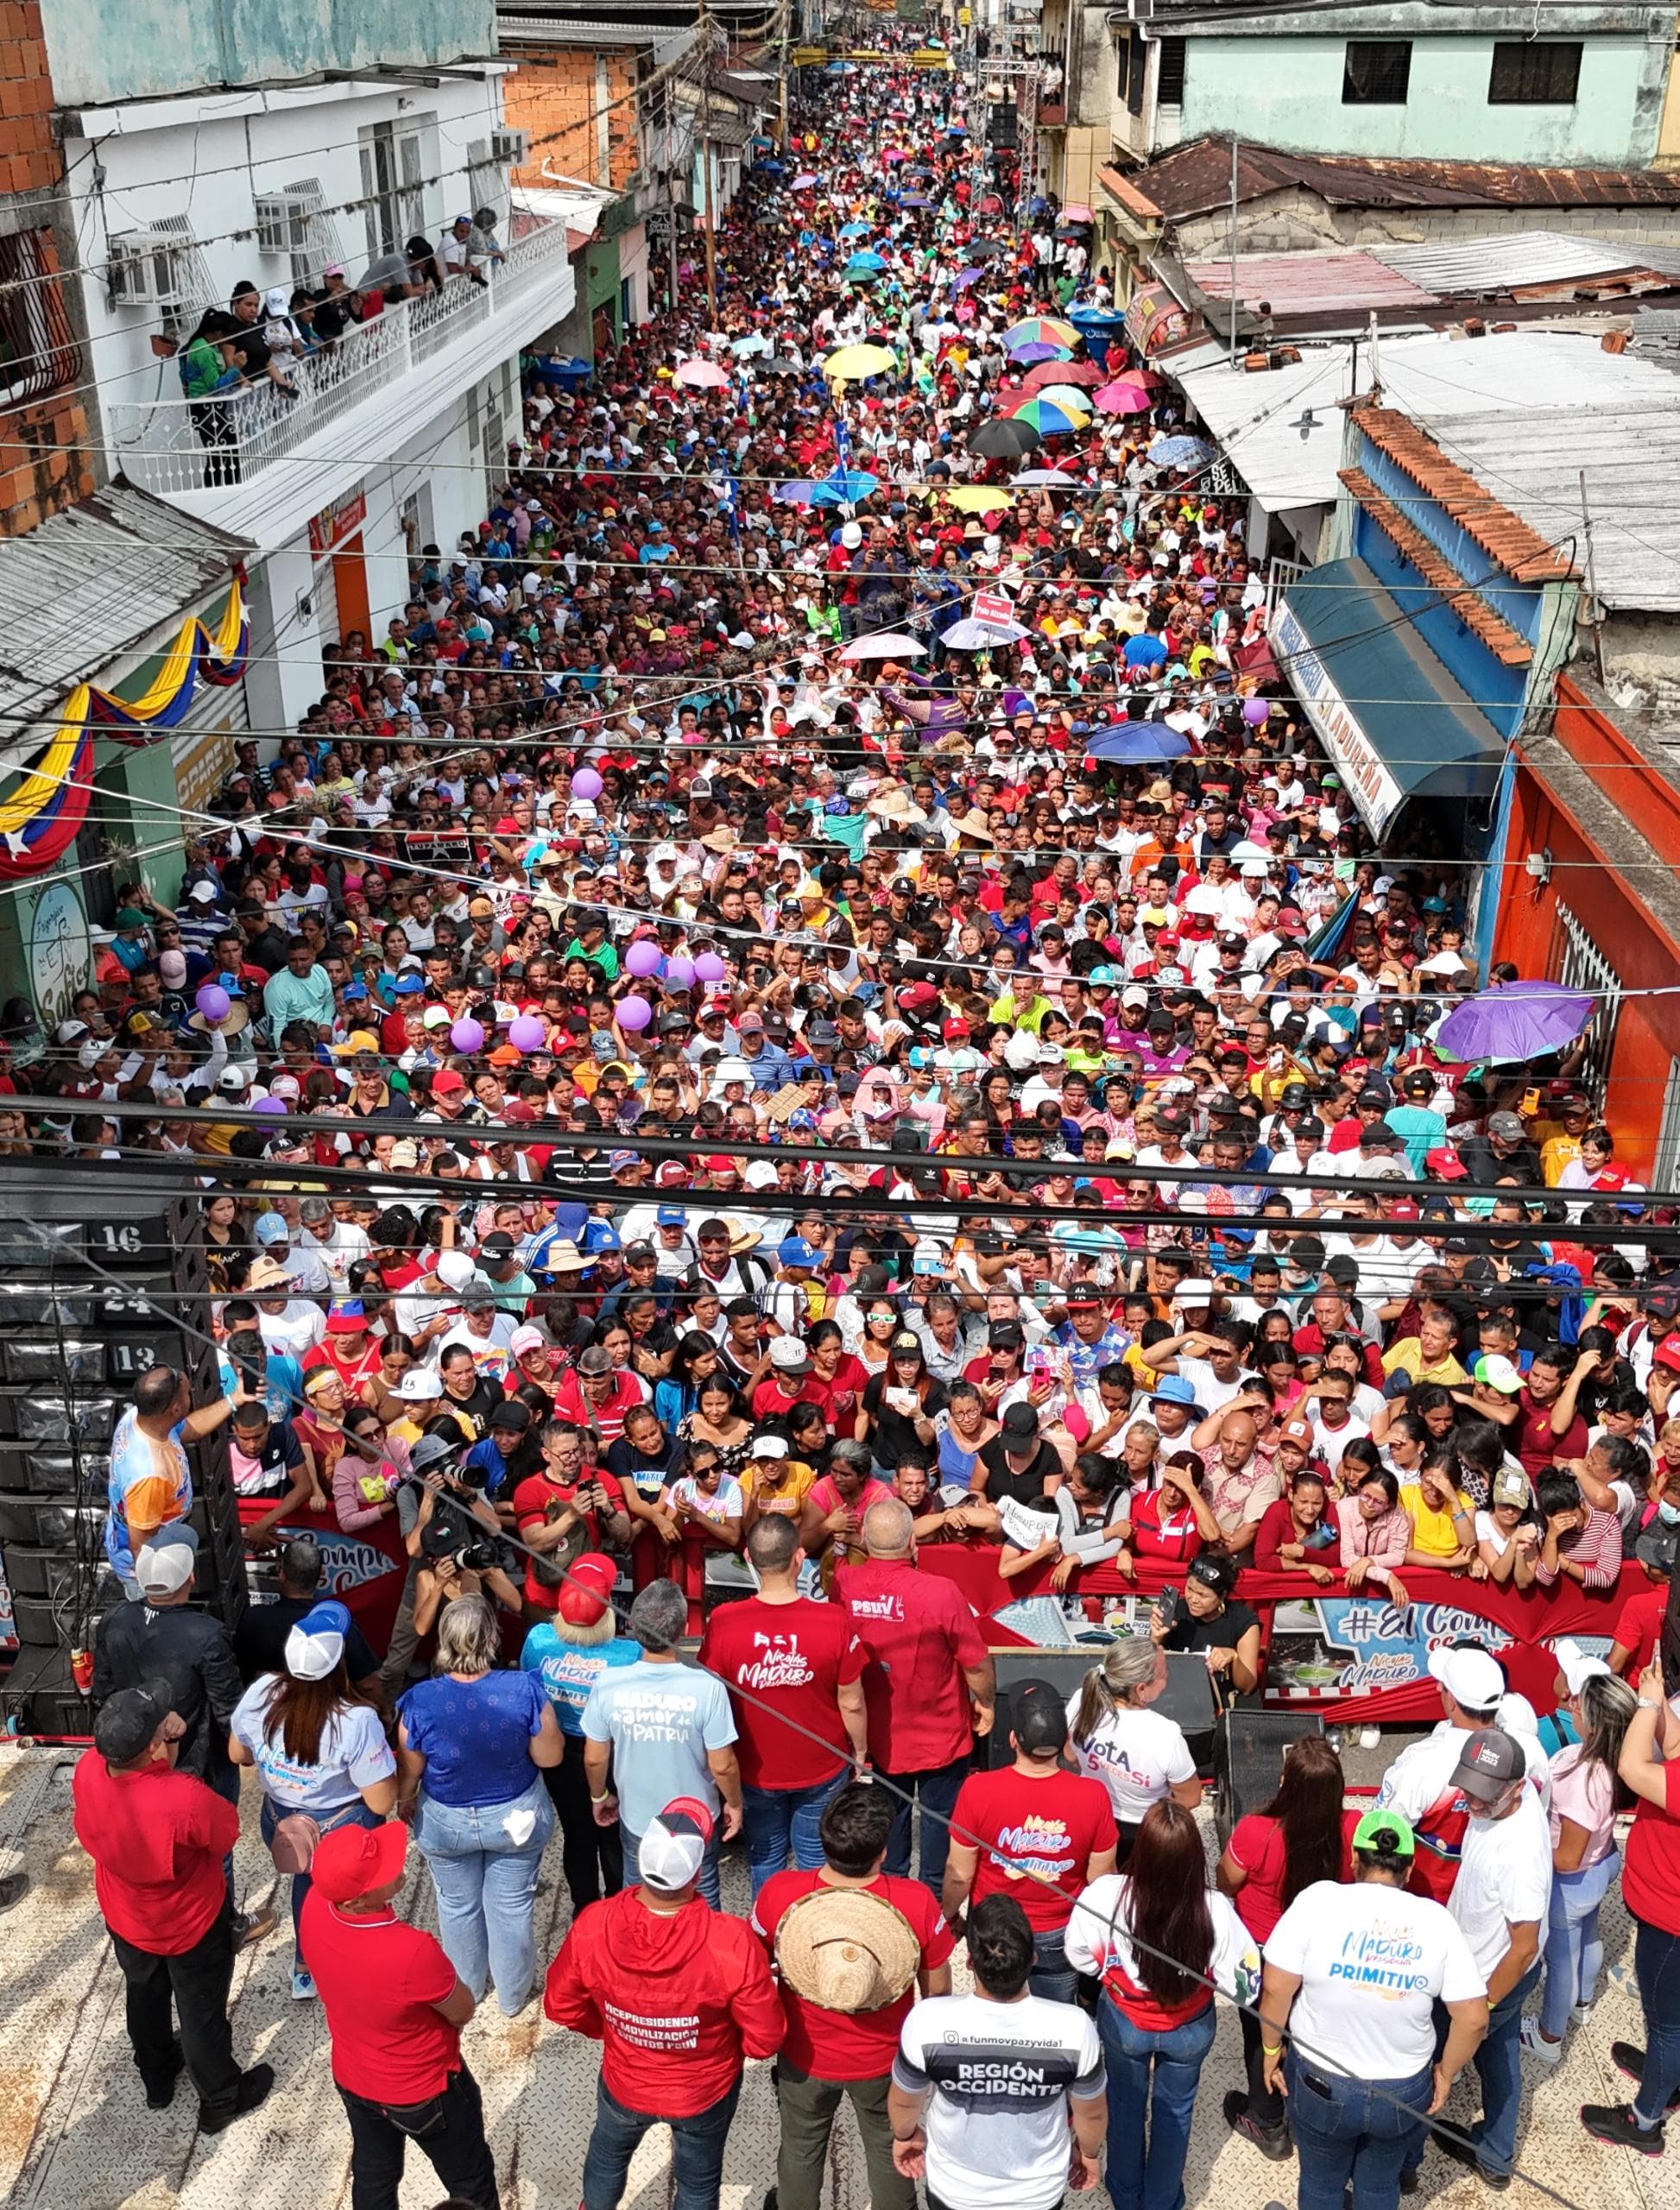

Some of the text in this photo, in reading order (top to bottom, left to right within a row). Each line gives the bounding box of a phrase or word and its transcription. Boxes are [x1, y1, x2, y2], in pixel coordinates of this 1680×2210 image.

[102, 1225, 142, 1253] 16
[103, 1286, 151, 1314] 24
[117, 1345, 156, 1371] 13
[1087, 1753, 1100, 1771] 5
[1342, 1930, 1424, 1961] MADURO
[1329, 1962, 1429, 1991] PRIMITIVO
[604, 1999, 700, 2028] VICEPRESIDENCIA
[957, 2061, 1045, 2083] REGIÓN
[939, 2078, 1064, 2098] OCCIDENTE
